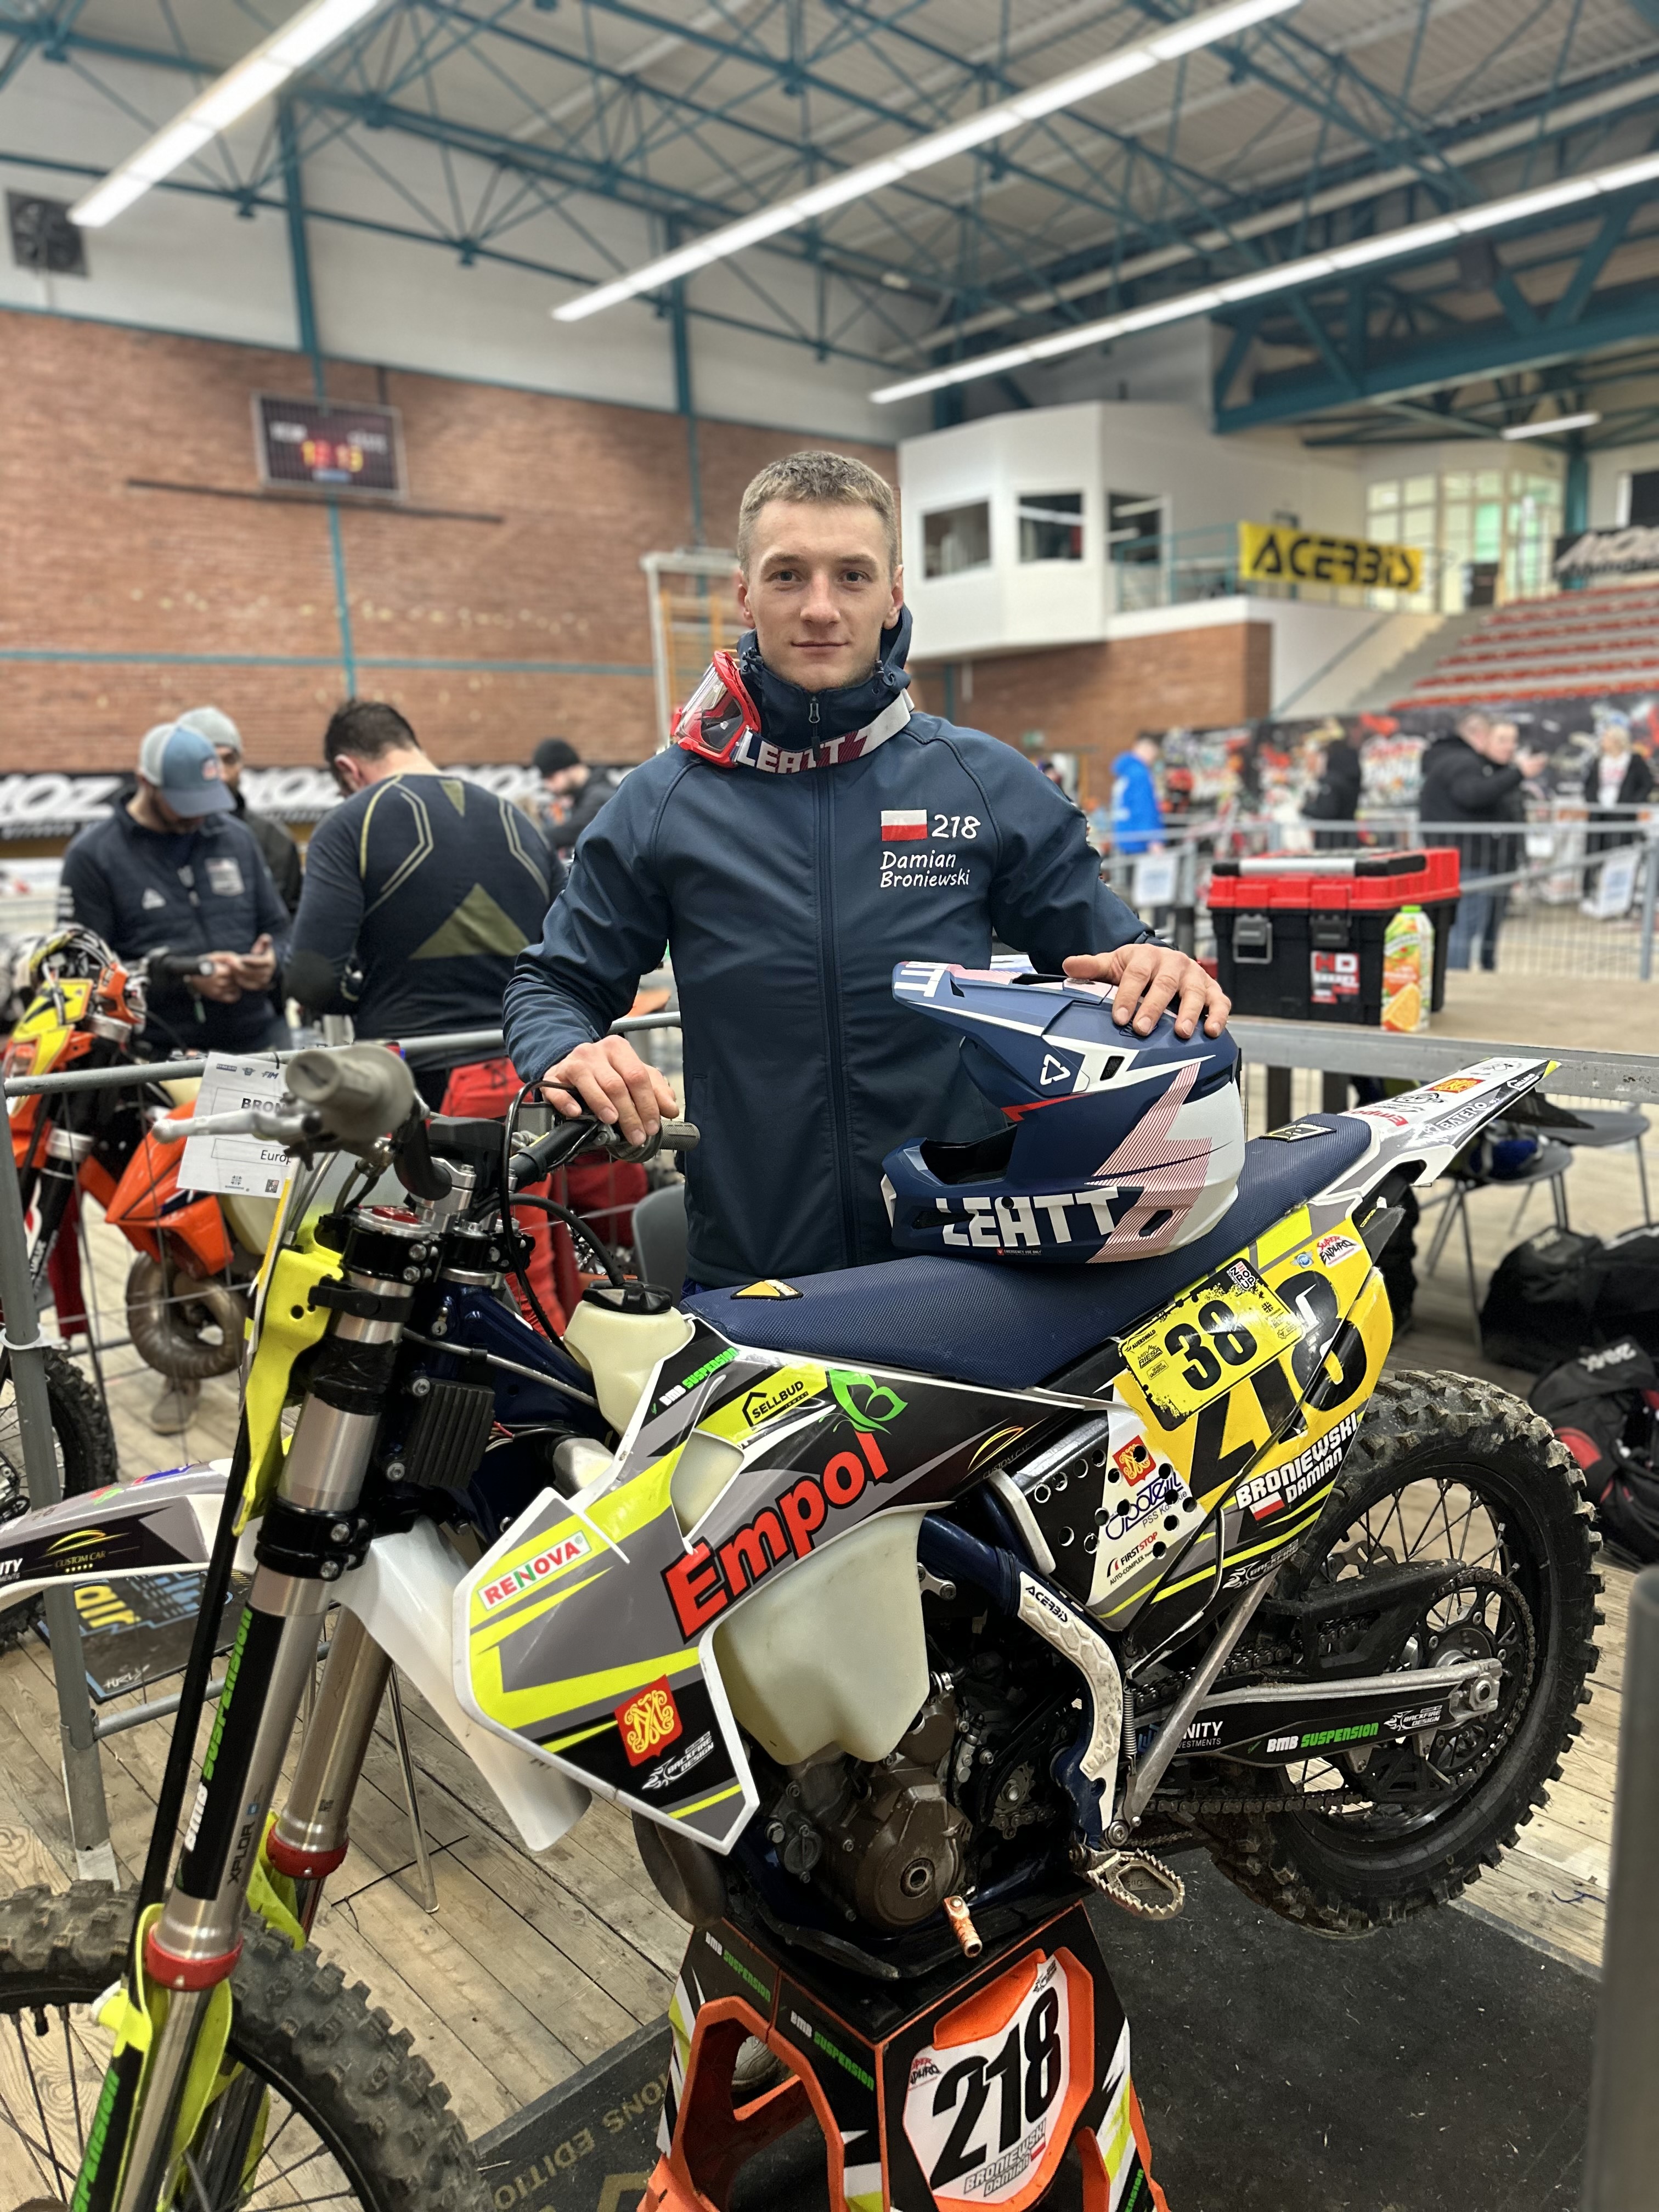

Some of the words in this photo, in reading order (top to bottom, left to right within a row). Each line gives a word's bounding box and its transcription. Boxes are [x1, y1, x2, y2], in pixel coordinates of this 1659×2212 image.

[1252, 534, 1415, 587] ACERBIS
[932, 814, 981, 839] 218
[880, 850, 956, 870] Damian
[880, 868, 970, 888] Broniewski
[241, 1098, 286, 1116] BRON
[260, 1149, 291, 1165] Europ
[935, 1186, 1119, 1247] LEATT
[1164, 1300, 1257, 1391] 38
[659, 1385, 686, 1406] BMB
[682, 1347, 740, 1389] SUSPENSION
[752, 1381, 804, 1419] SELLBUD
[1235, 1412, 1358, 1509] BRONIEWSKI
[1285, 1447, 1342, 1503] DAMIAN
[662, 1430, 889, 1639] Empol
[1142, 1511, 1159, 1528] PSS
[1025, 1585, 1068, 1622] ACERBIS
[1183, 1721, 1223, 1740] NITY
[1403, 1710, 1442, 1723] BACKFIRE
[1412, 1716, 1440, 1726] DESIGN
[667, 1735, 713, 1774] BACKFIRE
[1176, 1738, 1221, 1749] VESTMENTS
[1266, 1735, 1299, 1753] BMB
[1300, 1722, 1379, 1748] SUSPENSION
[681, 1742, 714, 1772] DESIGN
[227, 1821, 256, 1886] XPLOR
[930, 1987, 1062, 2191] 218
[494, 2126, 596, 2210] EDITIO
[964, 2118, 1047, 2195] BRONIEWSKI
[983, 2154, 1030, 2197] DAMIAN
